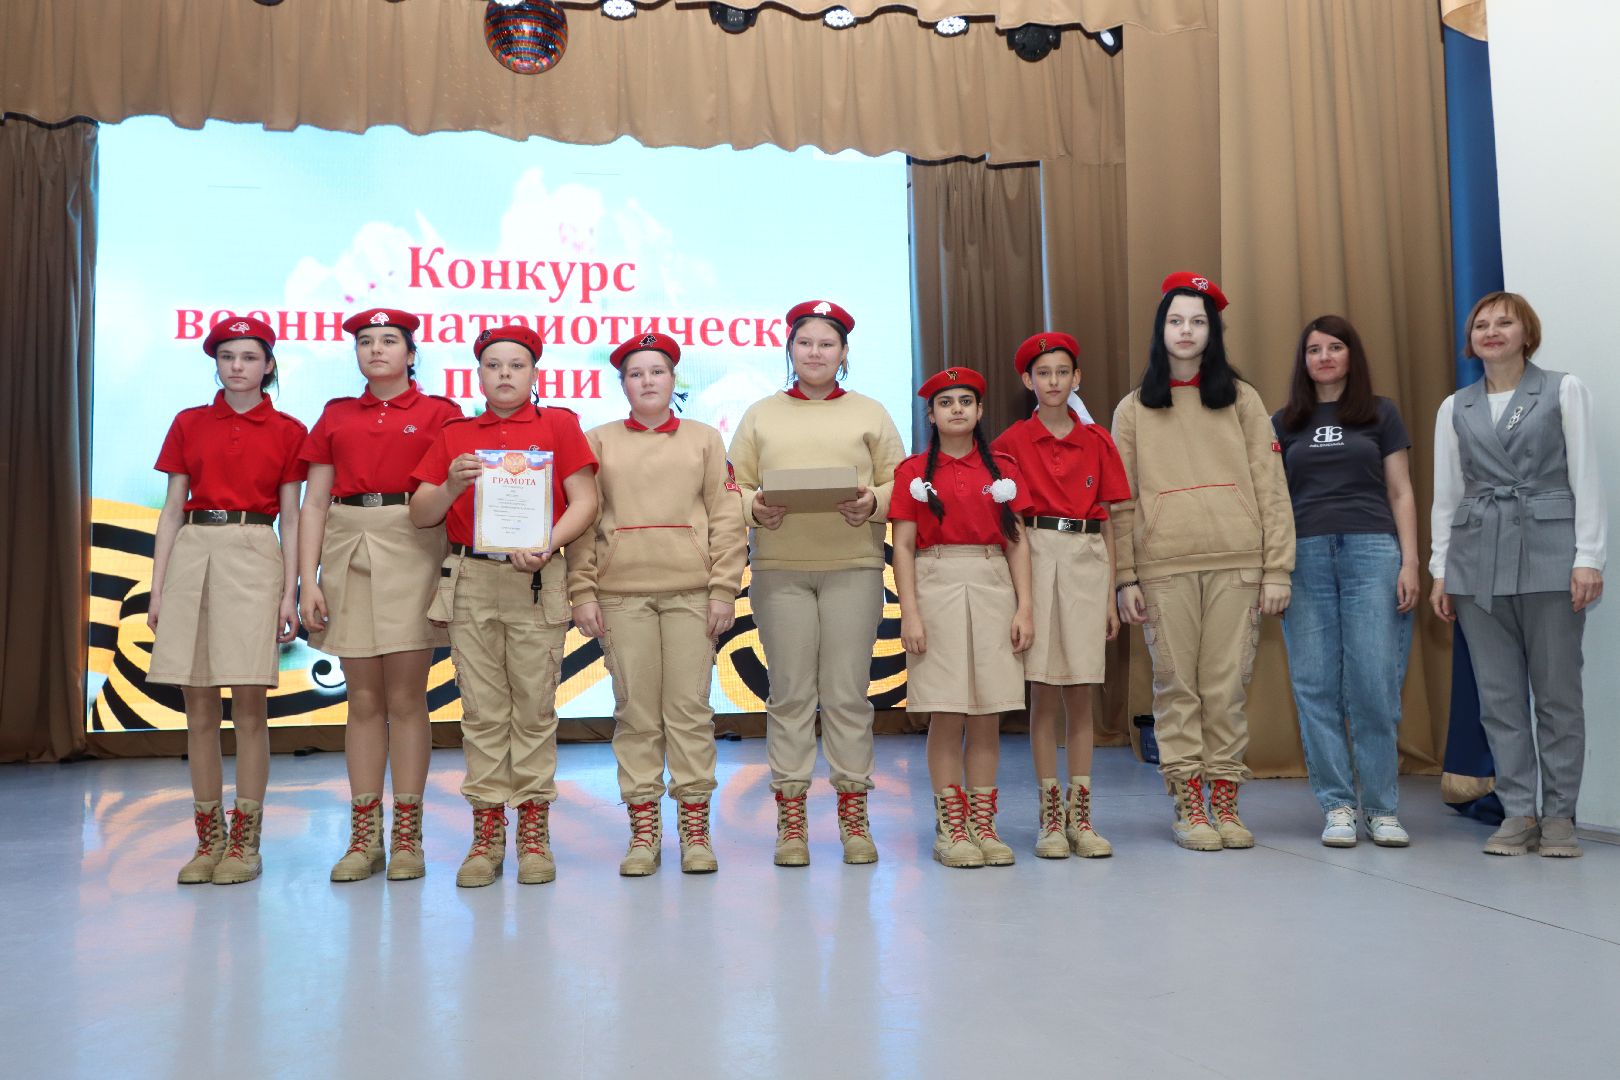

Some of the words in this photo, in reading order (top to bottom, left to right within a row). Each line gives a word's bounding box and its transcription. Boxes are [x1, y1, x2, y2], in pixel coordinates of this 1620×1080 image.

[408, 246, 636, 303] Конкурс
[443, 368, 602, 399] пни
[492, 476, 536, 485] ГРАМОТА
